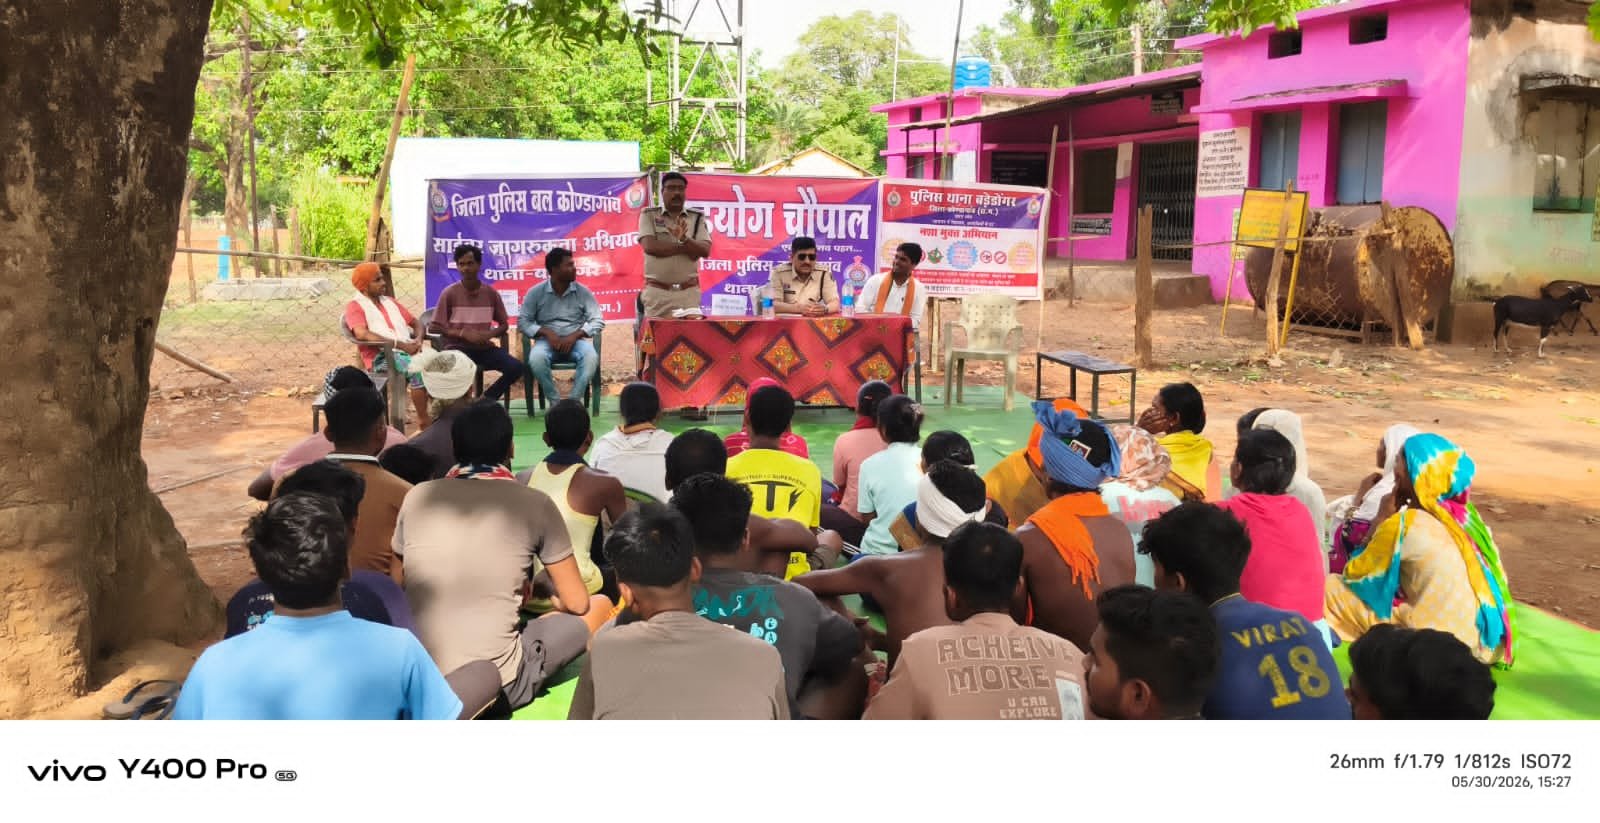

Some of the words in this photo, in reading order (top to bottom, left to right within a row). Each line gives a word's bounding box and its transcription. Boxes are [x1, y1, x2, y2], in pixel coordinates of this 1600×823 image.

[452, 193, 486, 217] जिला
[488, 182, 527, 223] पुलिस
[530, 190, 553, 212] बल
[556, 182, 622, 214] कोण्डागांव
[910, 189, 944, 206] पुलिस
[946, 193, 973, 205] थाना
[690, 184, 775, 239] योग
[783, 185, 872, 239] चौपाल
[920, 227, 937, 237] नशा
[940, 229, 960, 240] मुक्त
[962, 228, 998, 240] अभियान
[736, 255, 773, 277] पुलिस
[1230, 616, 1308, 648] VIRAT
[945, 664, 1052, 696] MORE
[1258, 645, 1331, 708] 18
[1000, 706, 1057, 720] EXPLORE
[1008, 697, 1016, 707] U
[1022, 695, 1048, 706] CAN
